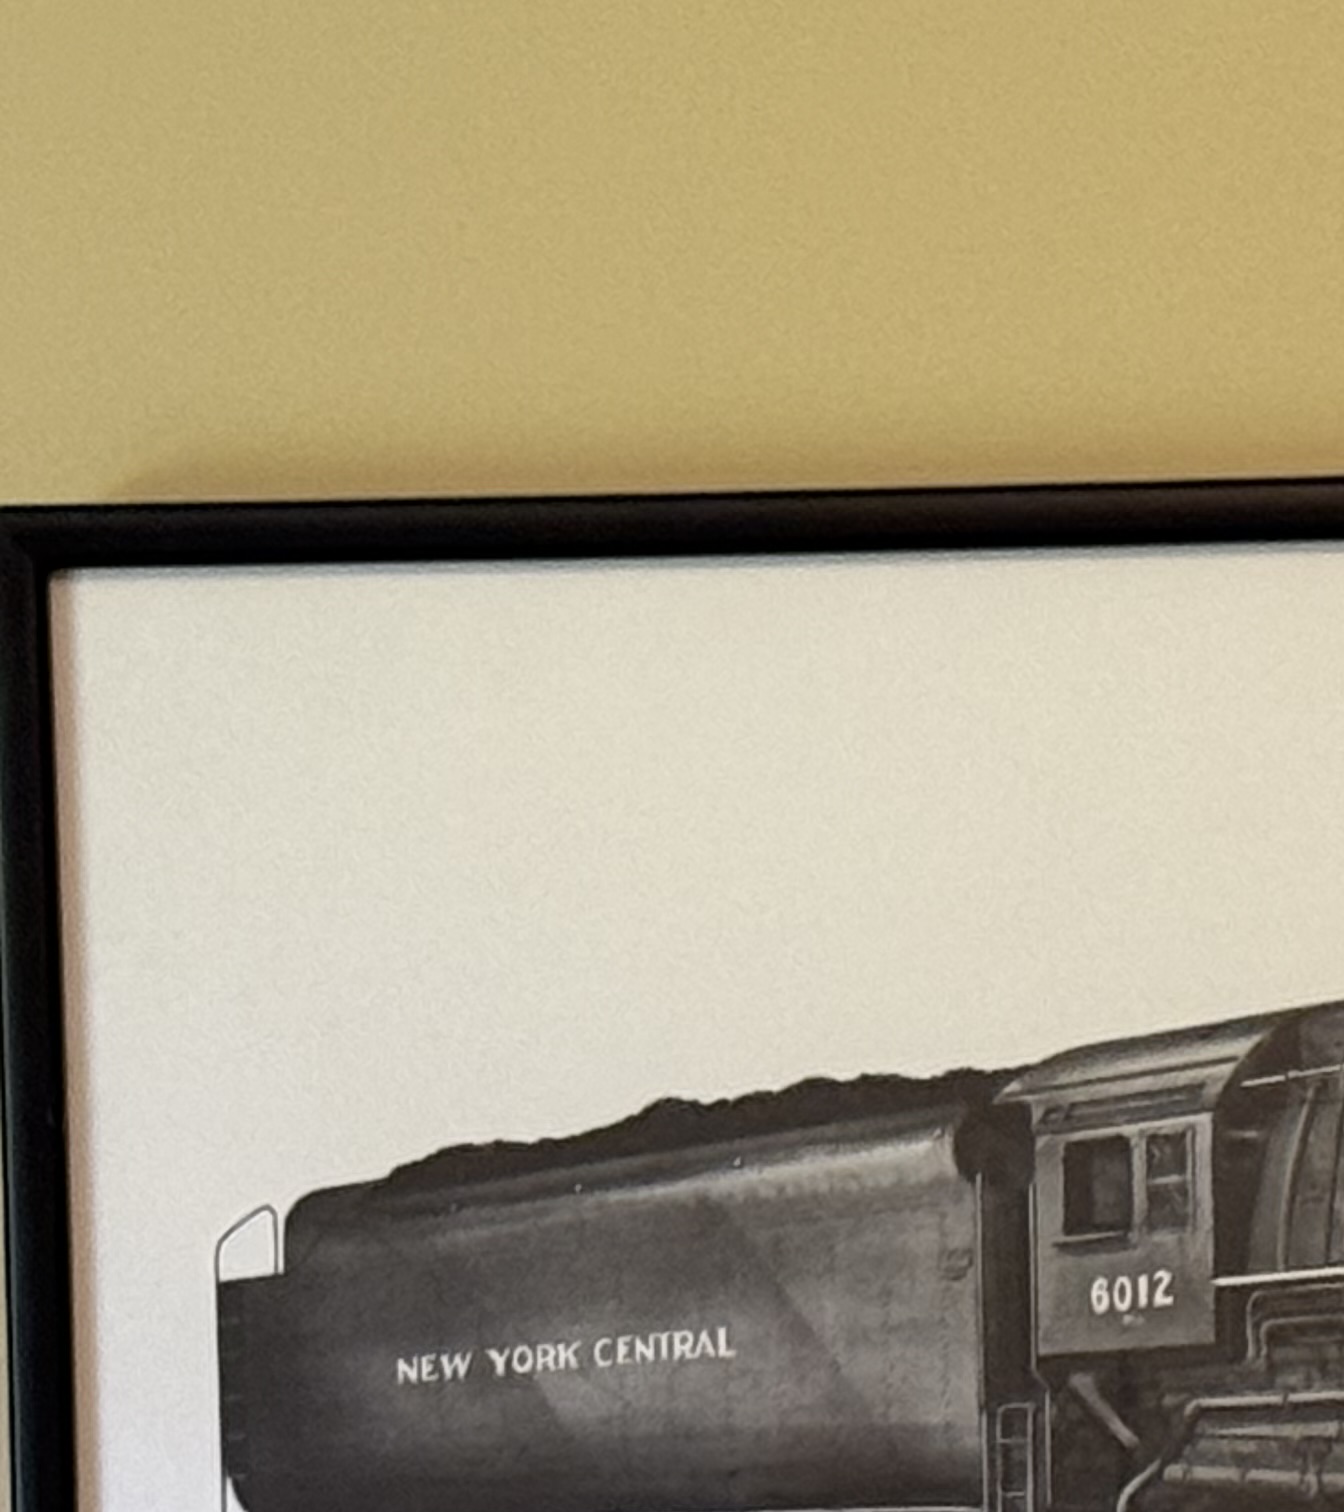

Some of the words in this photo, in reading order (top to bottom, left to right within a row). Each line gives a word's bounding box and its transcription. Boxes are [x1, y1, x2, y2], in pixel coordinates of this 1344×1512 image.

[1090, 1269, 1174, 1315] 6012
[396, 1351, 473, 1385] NEW
[487, 1340, 581, 1376] YORK
[593, 1326, 738, 1368] CENTRAL
